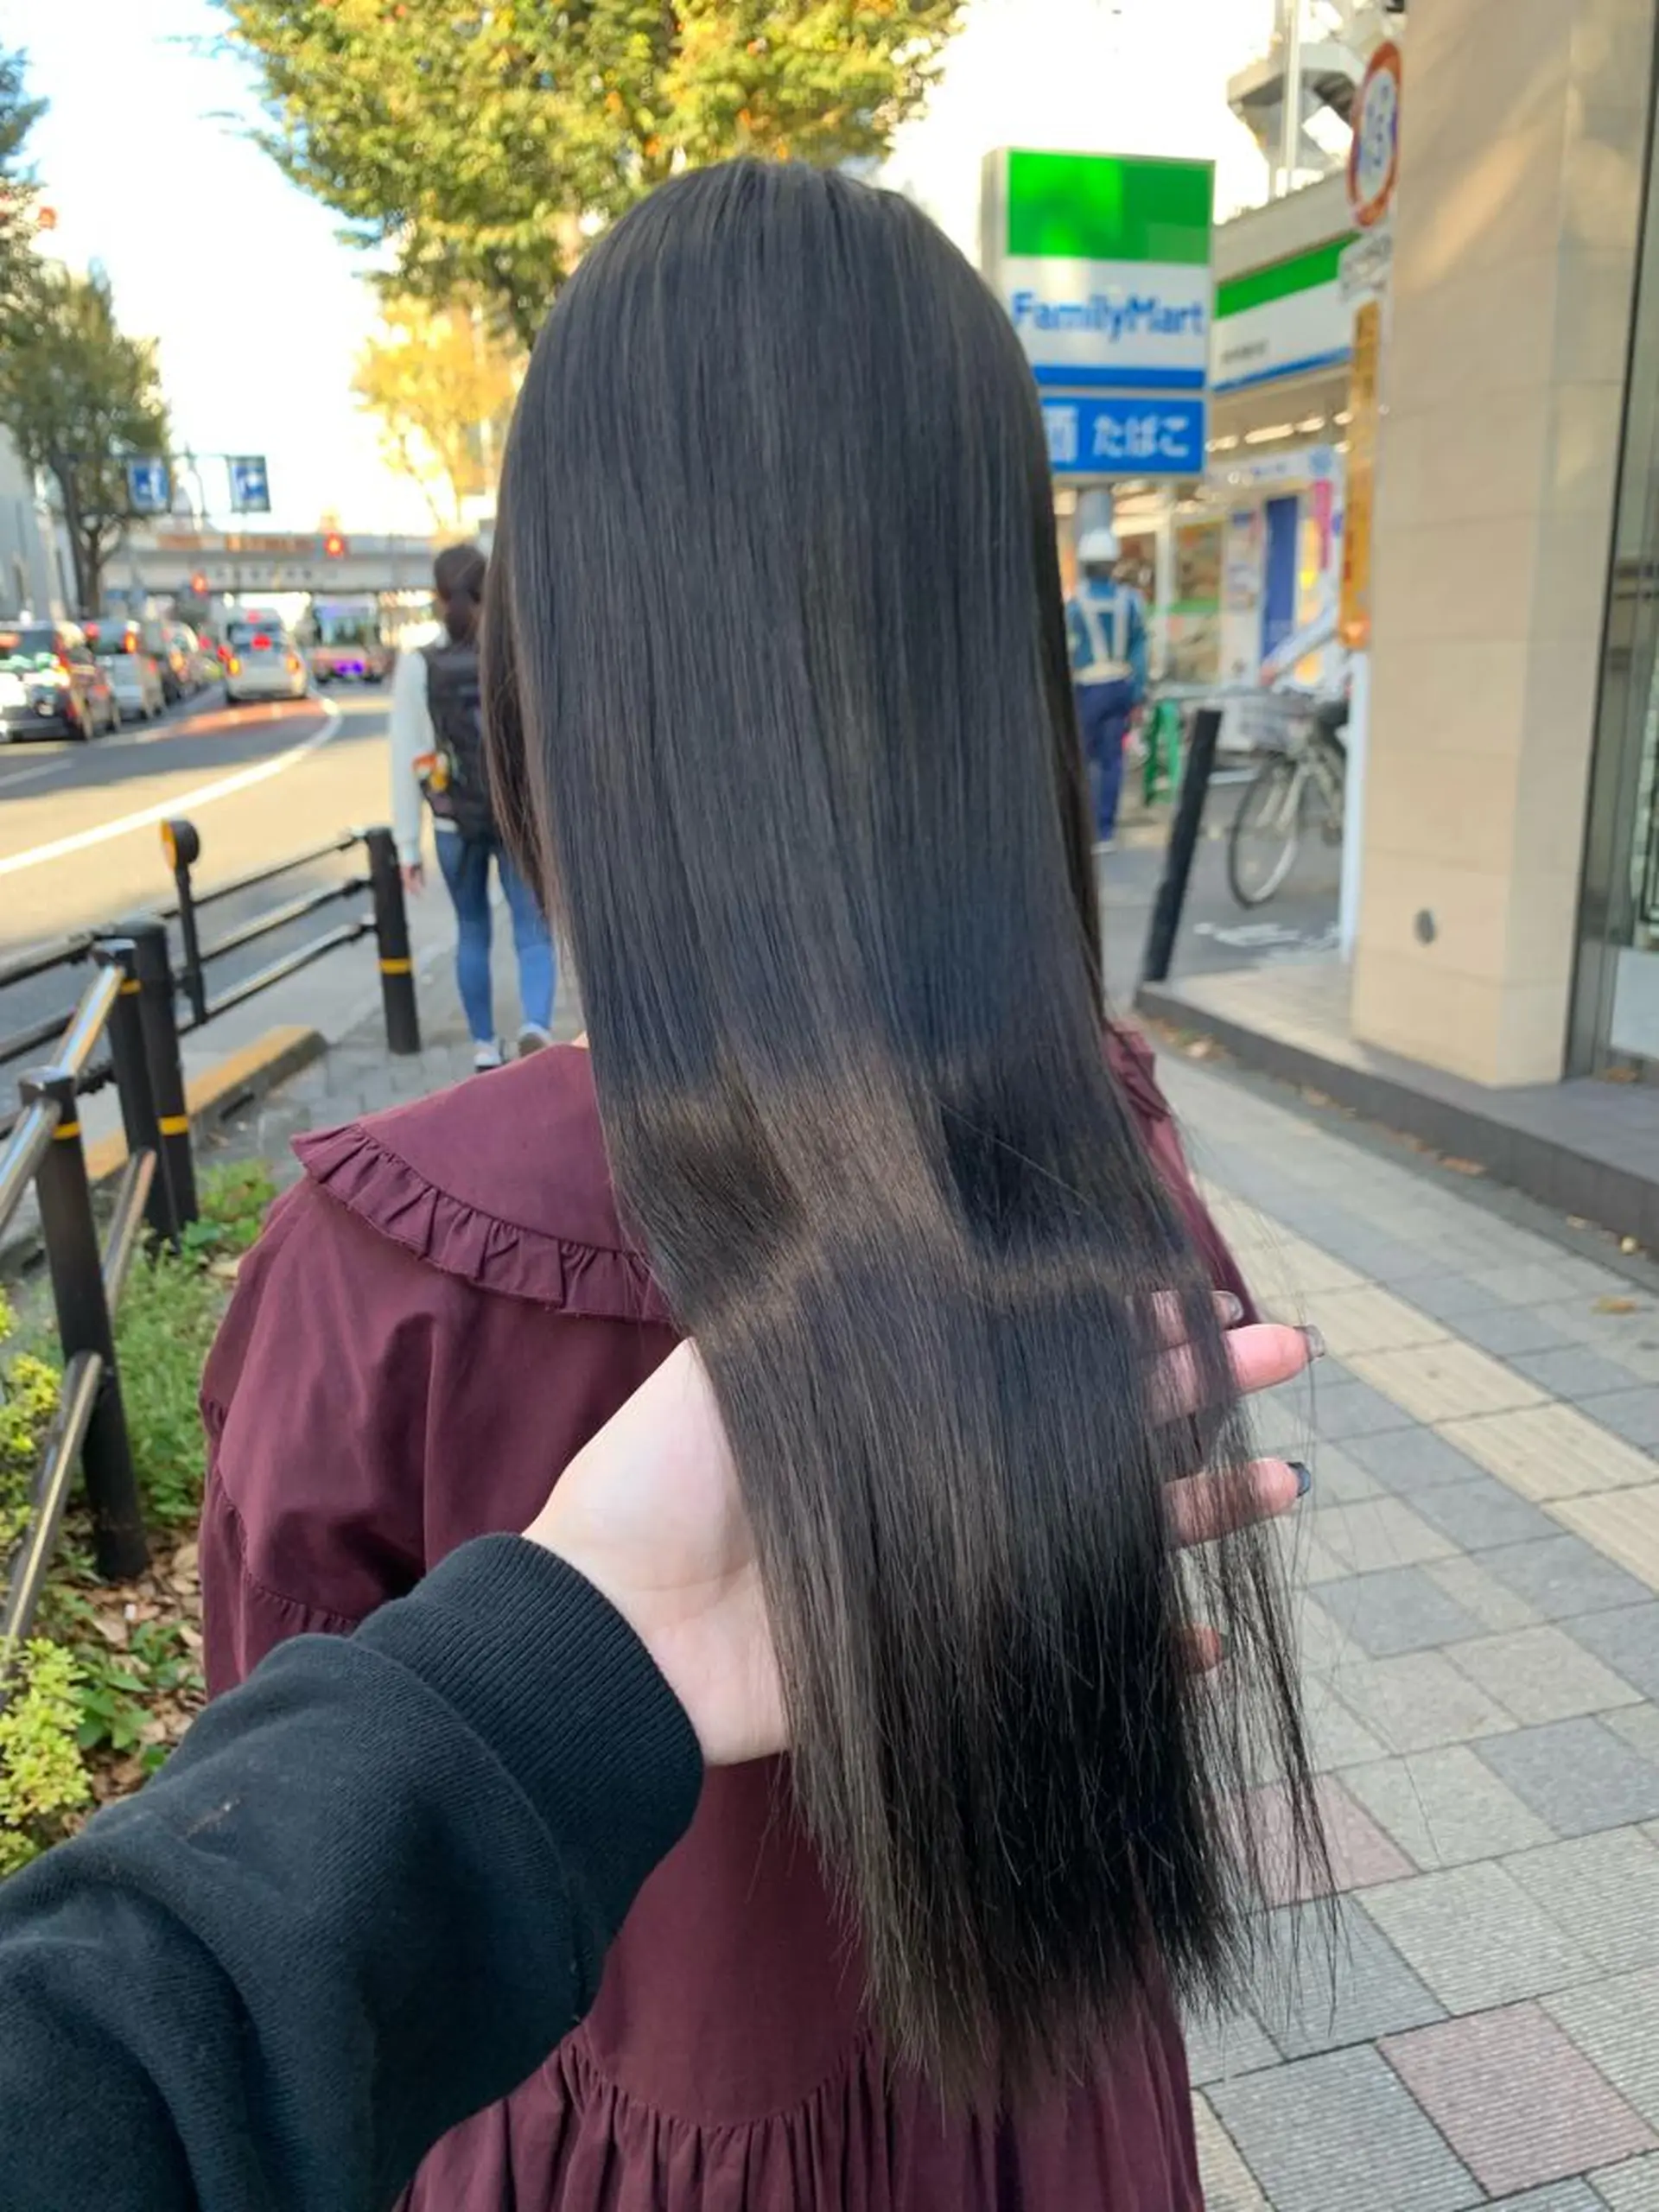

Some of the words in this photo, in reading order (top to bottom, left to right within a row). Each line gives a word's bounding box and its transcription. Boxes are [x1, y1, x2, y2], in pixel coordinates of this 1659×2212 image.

[1013, 291, 1205, 343] FamilyMart
[1092, 414, 1190, 459] たばこ
